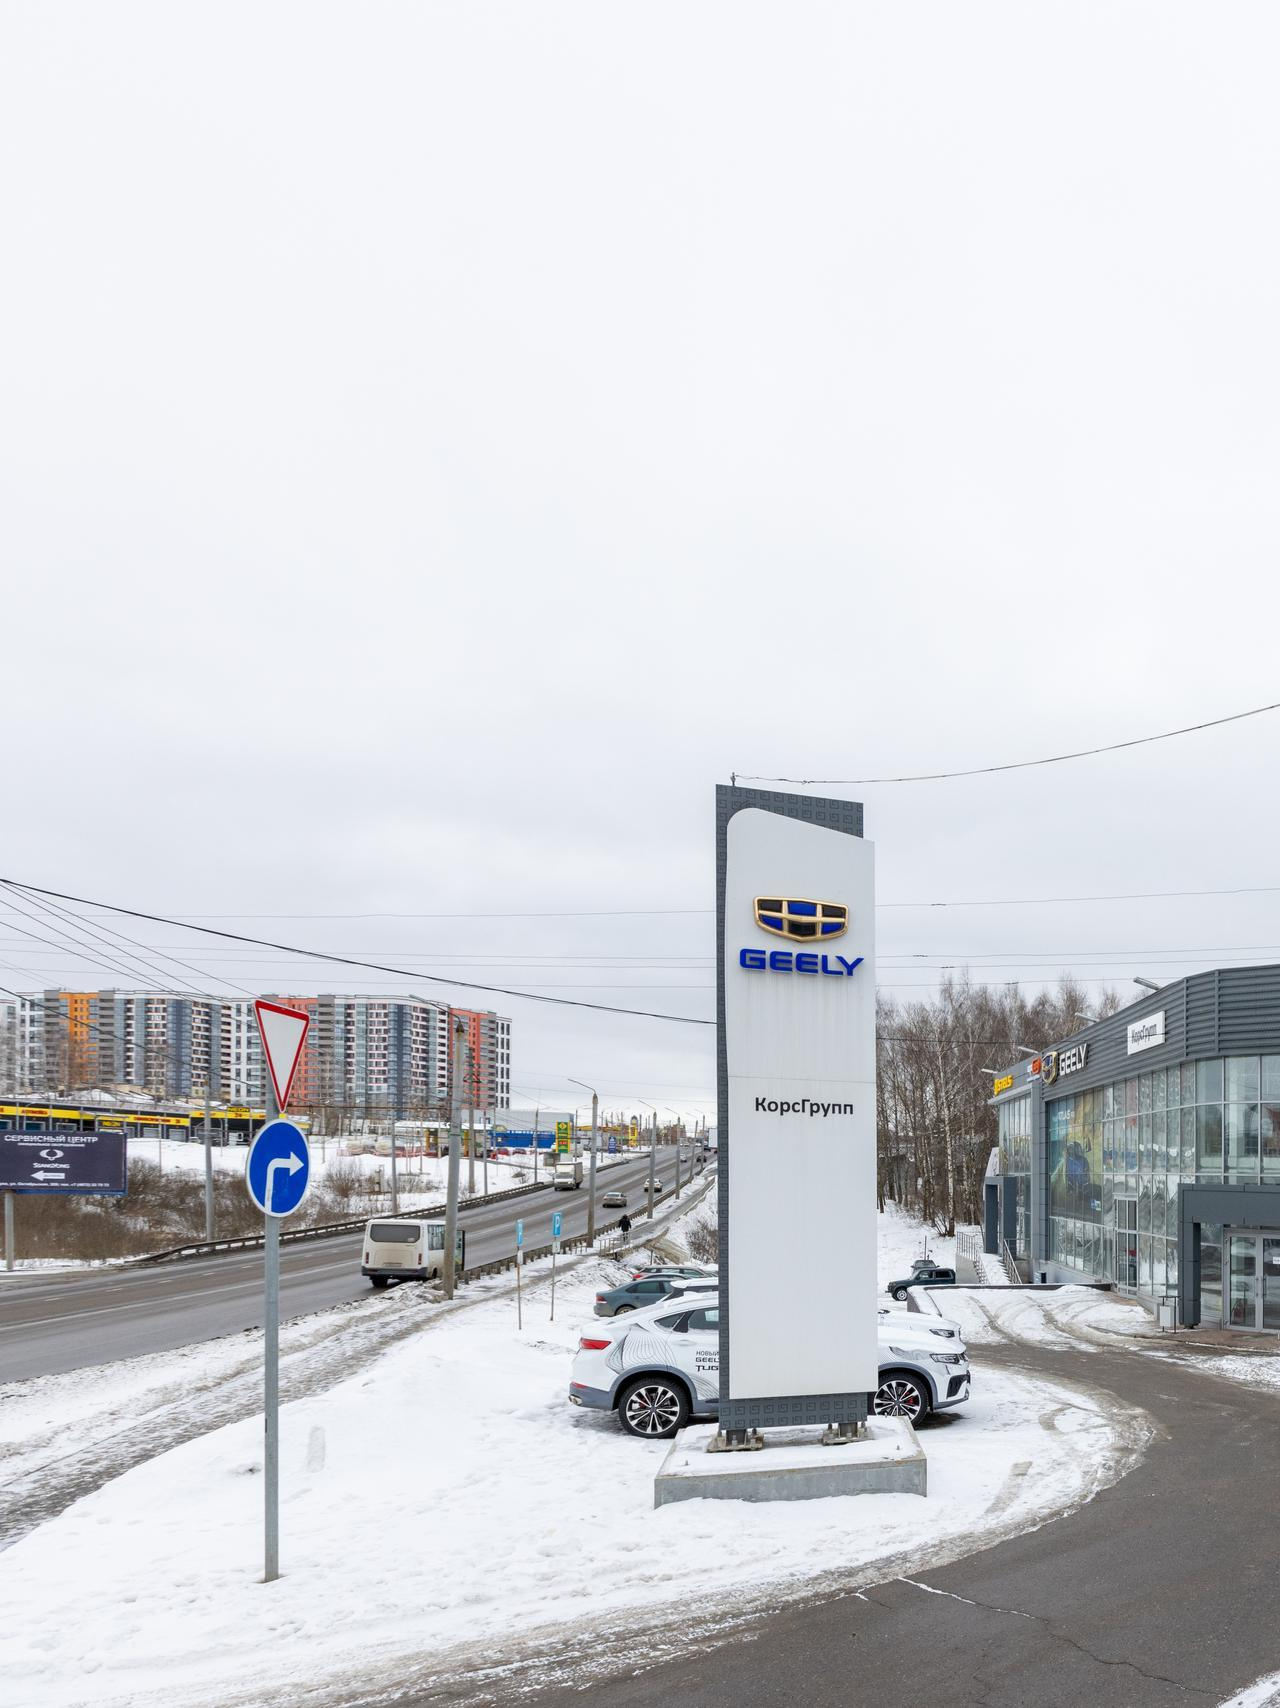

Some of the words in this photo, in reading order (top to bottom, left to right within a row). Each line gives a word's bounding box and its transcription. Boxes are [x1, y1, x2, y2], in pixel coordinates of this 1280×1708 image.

[740, 948, 865, 977] GEELY
[1059, 1043, 1087, 1077] GEELY
[755, 1097, 854, 1117] КорсГрупп
[4, 1134, 66, 1143] СЕРВИСНЫЙ
[67, 1136, 98, 1144] ЦЕНТР
